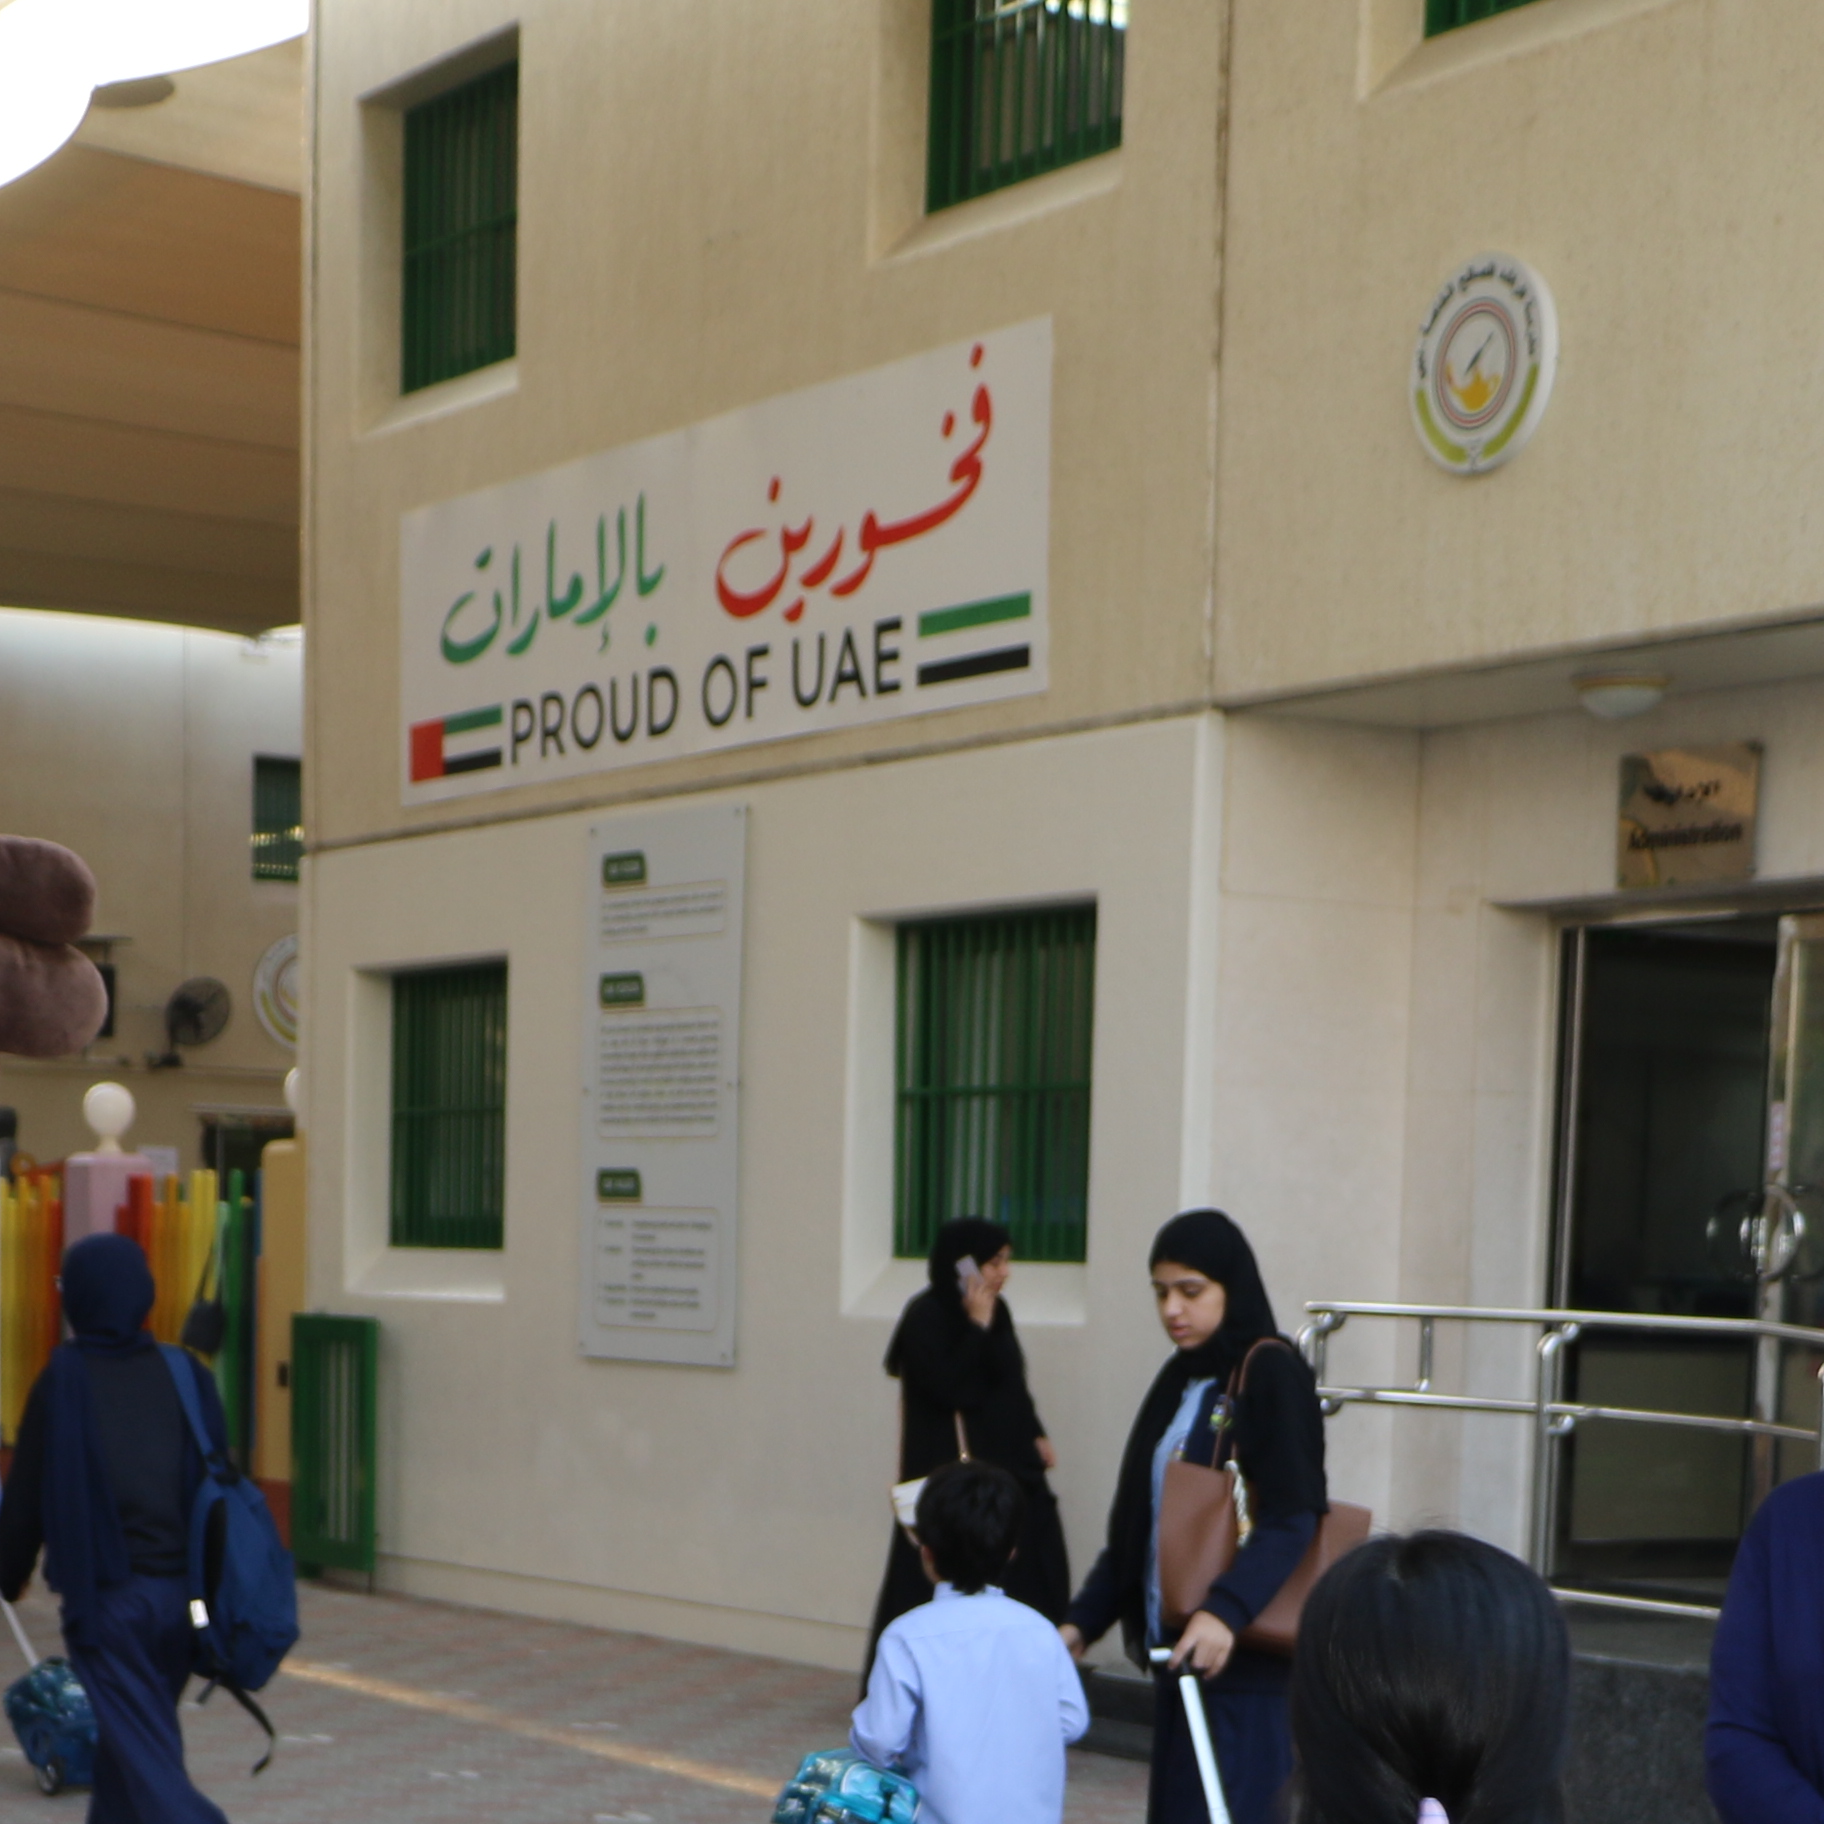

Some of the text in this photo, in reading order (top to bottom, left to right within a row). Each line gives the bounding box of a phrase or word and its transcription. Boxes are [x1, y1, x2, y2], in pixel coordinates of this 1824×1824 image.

[440, 342, 995, 665] فخورين بالإمارات
[509, 616, 903, 766] PROUD OF UAE
